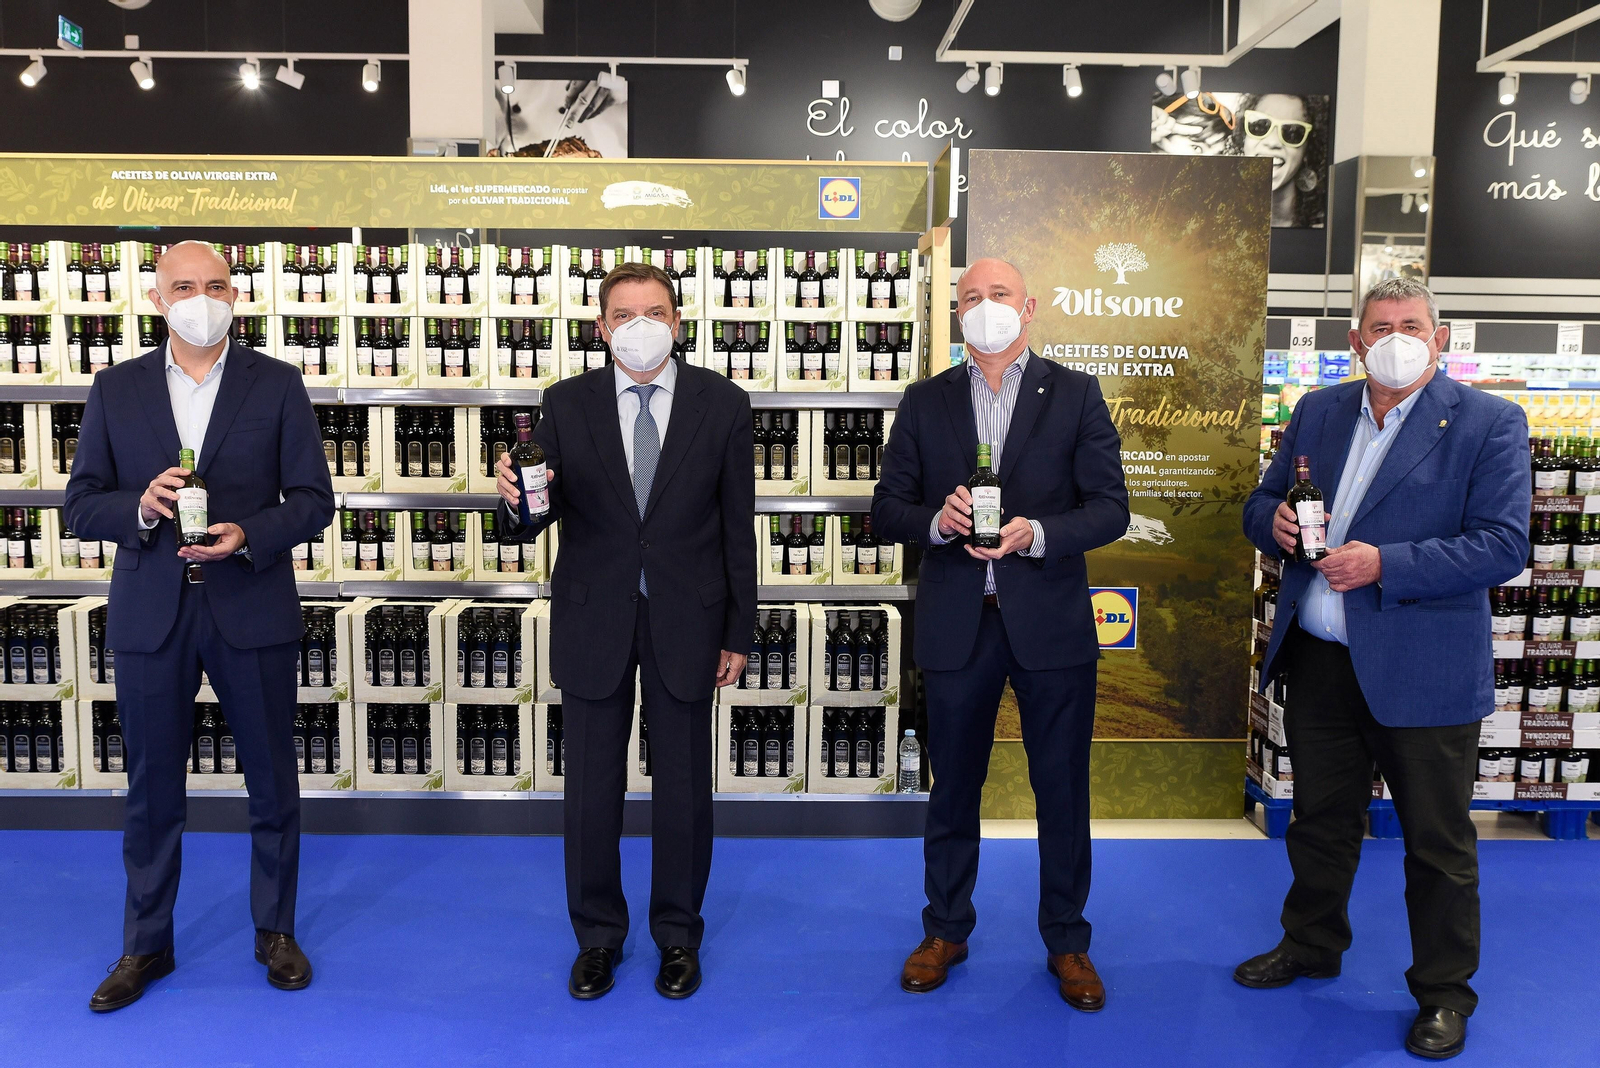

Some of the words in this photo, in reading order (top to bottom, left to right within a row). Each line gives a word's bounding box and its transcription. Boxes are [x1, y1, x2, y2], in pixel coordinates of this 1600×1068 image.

[806, 97, 854, 137] El
[874, 98, 973, 139] color
[1483, 110, 1562, 166] Qué
[1580, 127, 1600, 149] s
[111, 170, 153, 180] ACEITES
[155, 170, 169, 180] DE
[170, 171, 203, 180] OLIVA
[204, 171, 243, 181] VIRGEN
[245, 171, 278, 181] EXTRA
[430, 184, 449, 194] Lidl,
[451, 184, 459, 193] el
[460, 185, 473, 193] 1er
[474, 185, 550, 194] SUPERMERCADO
[562, 186, 588, 195] apostar
[1486, 173, 1567, 200] más
[92, 185, 115, 210] de
[123, 186, 184, 213] Olivar
[186, 186, 297, 216] Tradicional
[448, 197, 460, 205] por
[461, 196, 469, 204] el
[470, 196, 504, 205] OLIVAR
[506, 196, 570, 205] TRADICIONAL
[1051, 286, 1184, 318] Olisone
[1292, 336, 1314, 347] 0.95
[1042, 344, 1109, 359] ACEITES
[1113, 345, 1134, 359] DE
[1137, 345, 1189, 360] OLIVA
[1123, 363, 1175, 377] EXTRA
[1103, 395, 1246, 431] Tradicional
[1178, 453, 1210, 463] apostar
[1158, 467, 1217, 477] garantizando:
[1129, 478, 1141, 487] los
[1142, 479, 1190, 488] agricultores.
[1132, 489, 1161, 498] familias
[1163, 490, 1176, 498] del
[1534, 504, 1580, 512] TRADICIONAL
[1545, 571, 1570, 579] OLIVAR
[1533, 578, 1580, 586] TRADICIONAL
[1538, 642, 1562, 650] OLIVAR
[1535, 713, 1559, 721] OLIVAR
[1523, 720, 1569, 728] TRADICIONAL
[1517, 791, 1564, 799] TRADICIONAL
